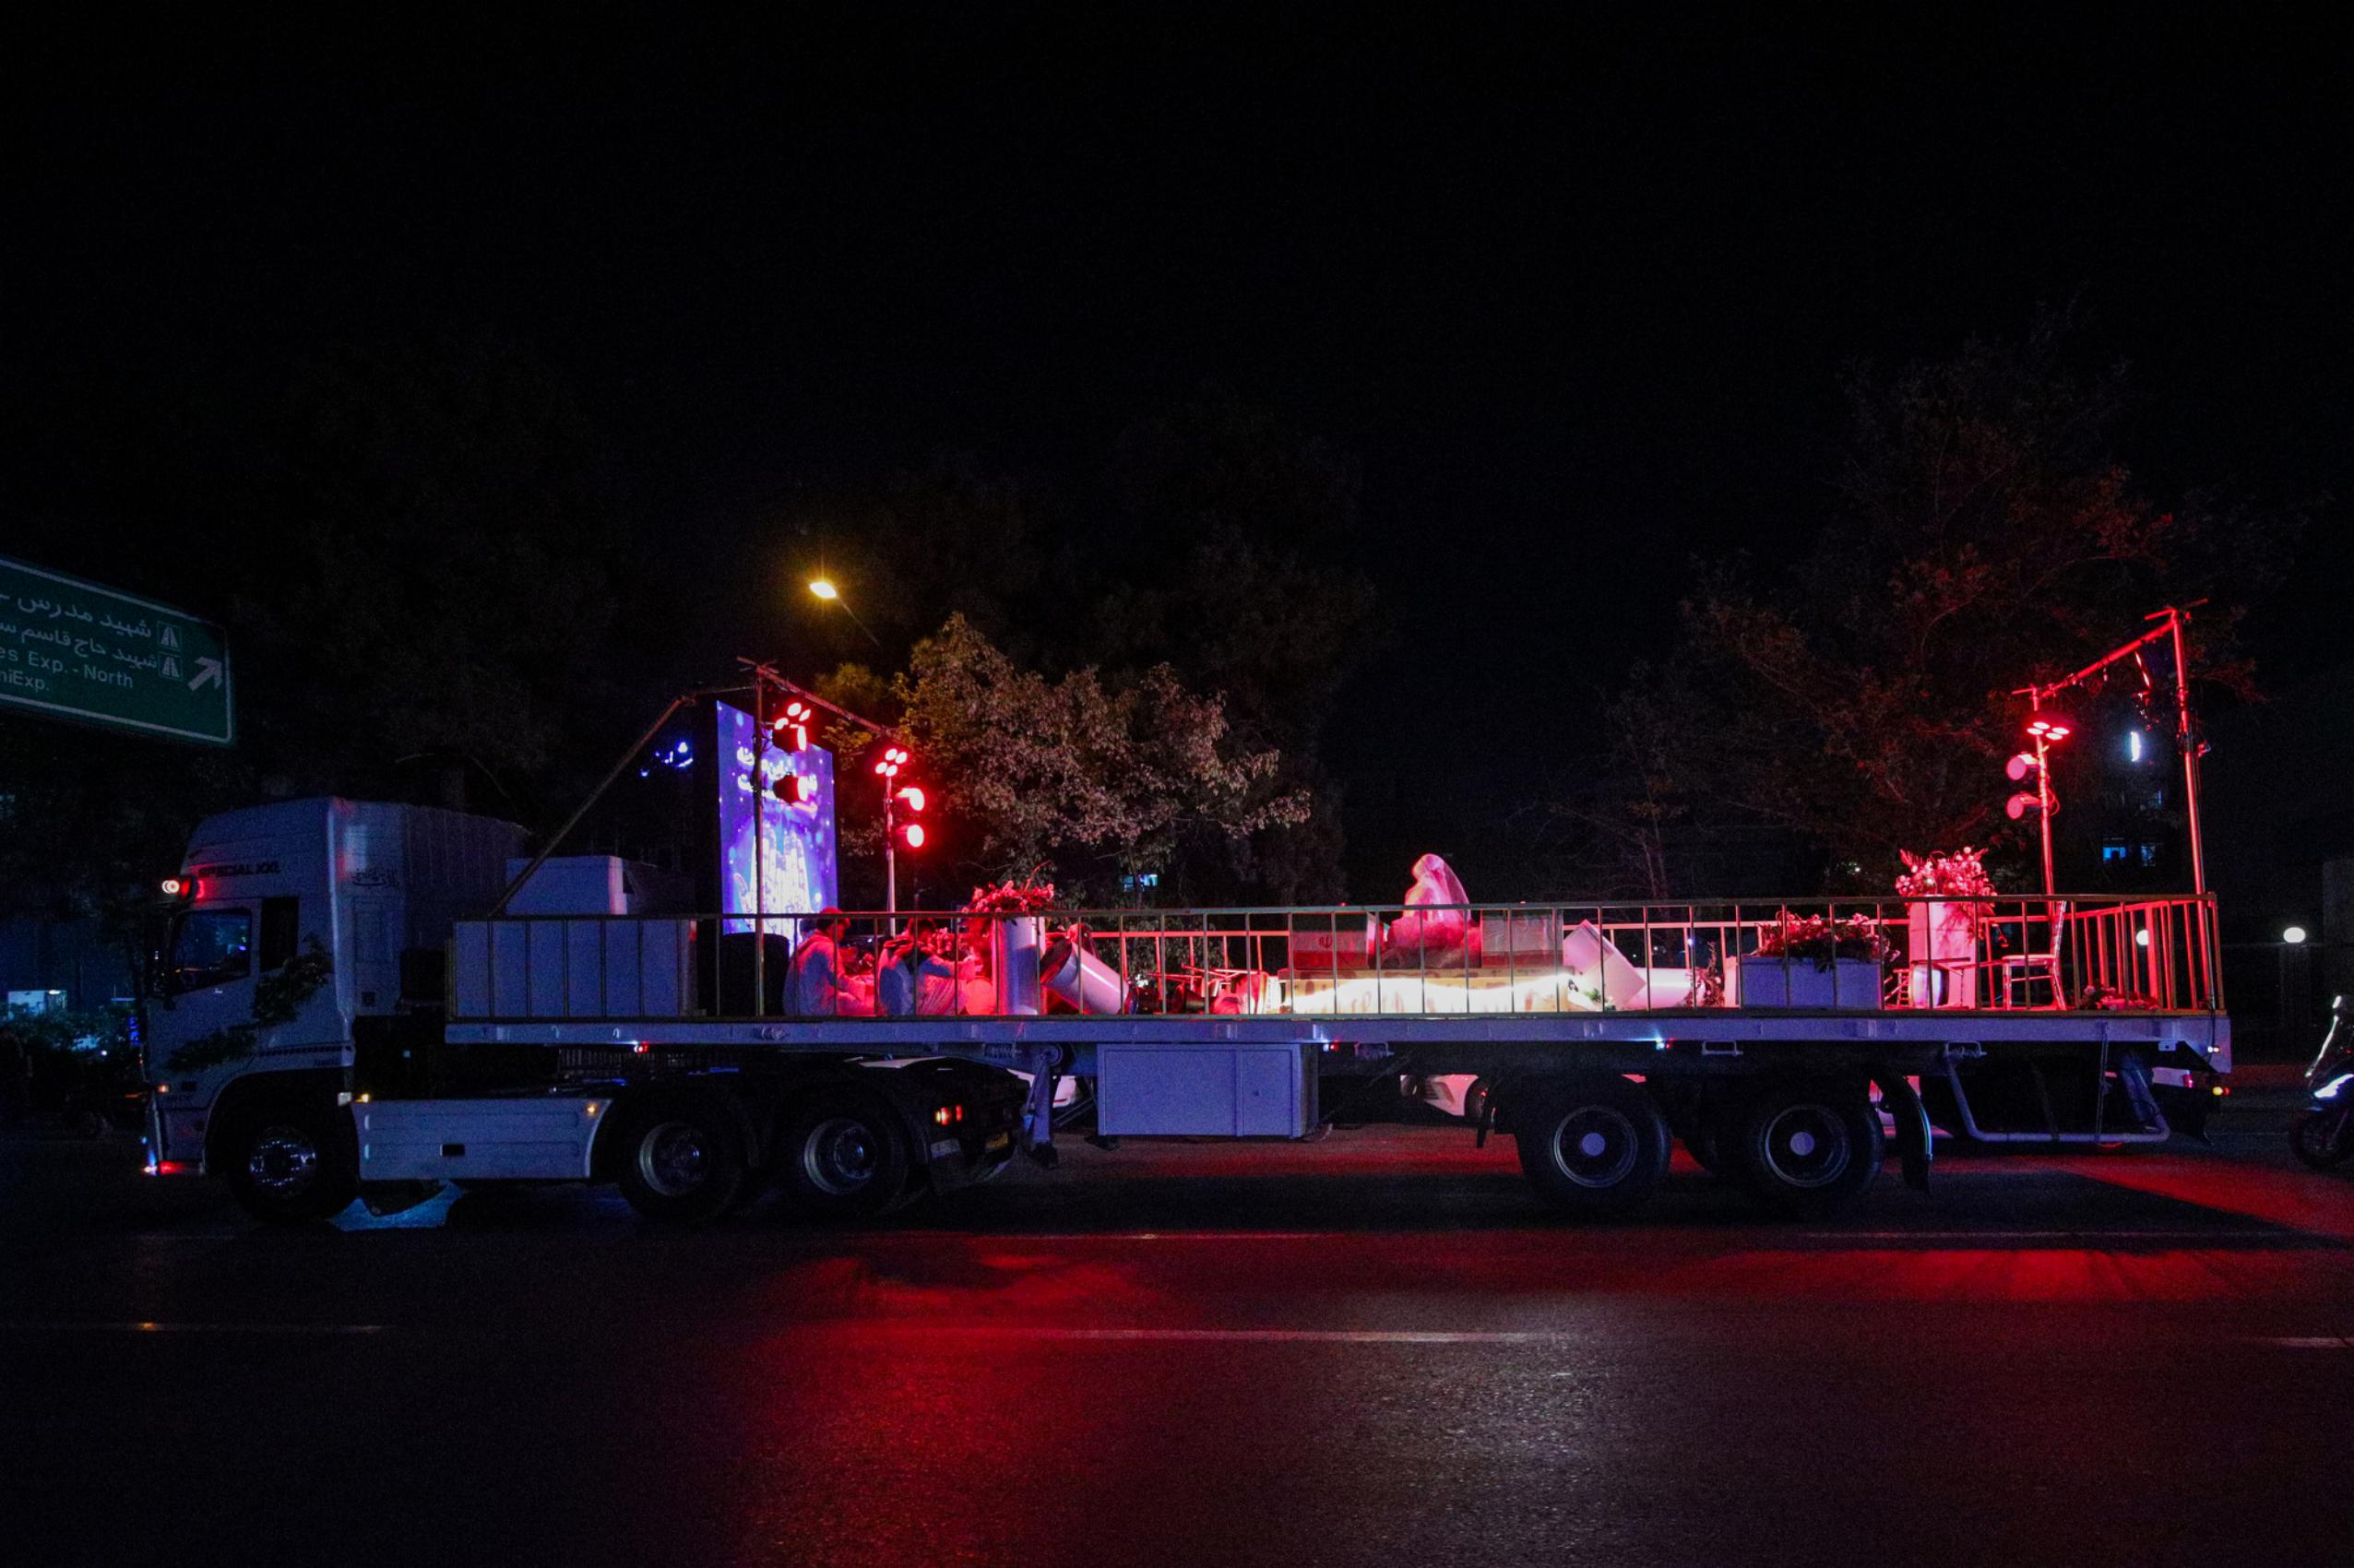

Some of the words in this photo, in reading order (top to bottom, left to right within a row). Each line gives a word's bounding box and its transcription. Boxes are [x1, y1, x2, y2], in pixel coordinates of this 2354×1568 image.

[18, 598, 93, 623] مدرس
[20, 626, 71, 647] قاسم
[100, 614, 151, 637] شهید
[74, 637, 107, 658] حاج
[28, 650, 68, 673] Exp.
[84, 664, 134, 688] North
[112, 648, 157, 670] شهید
